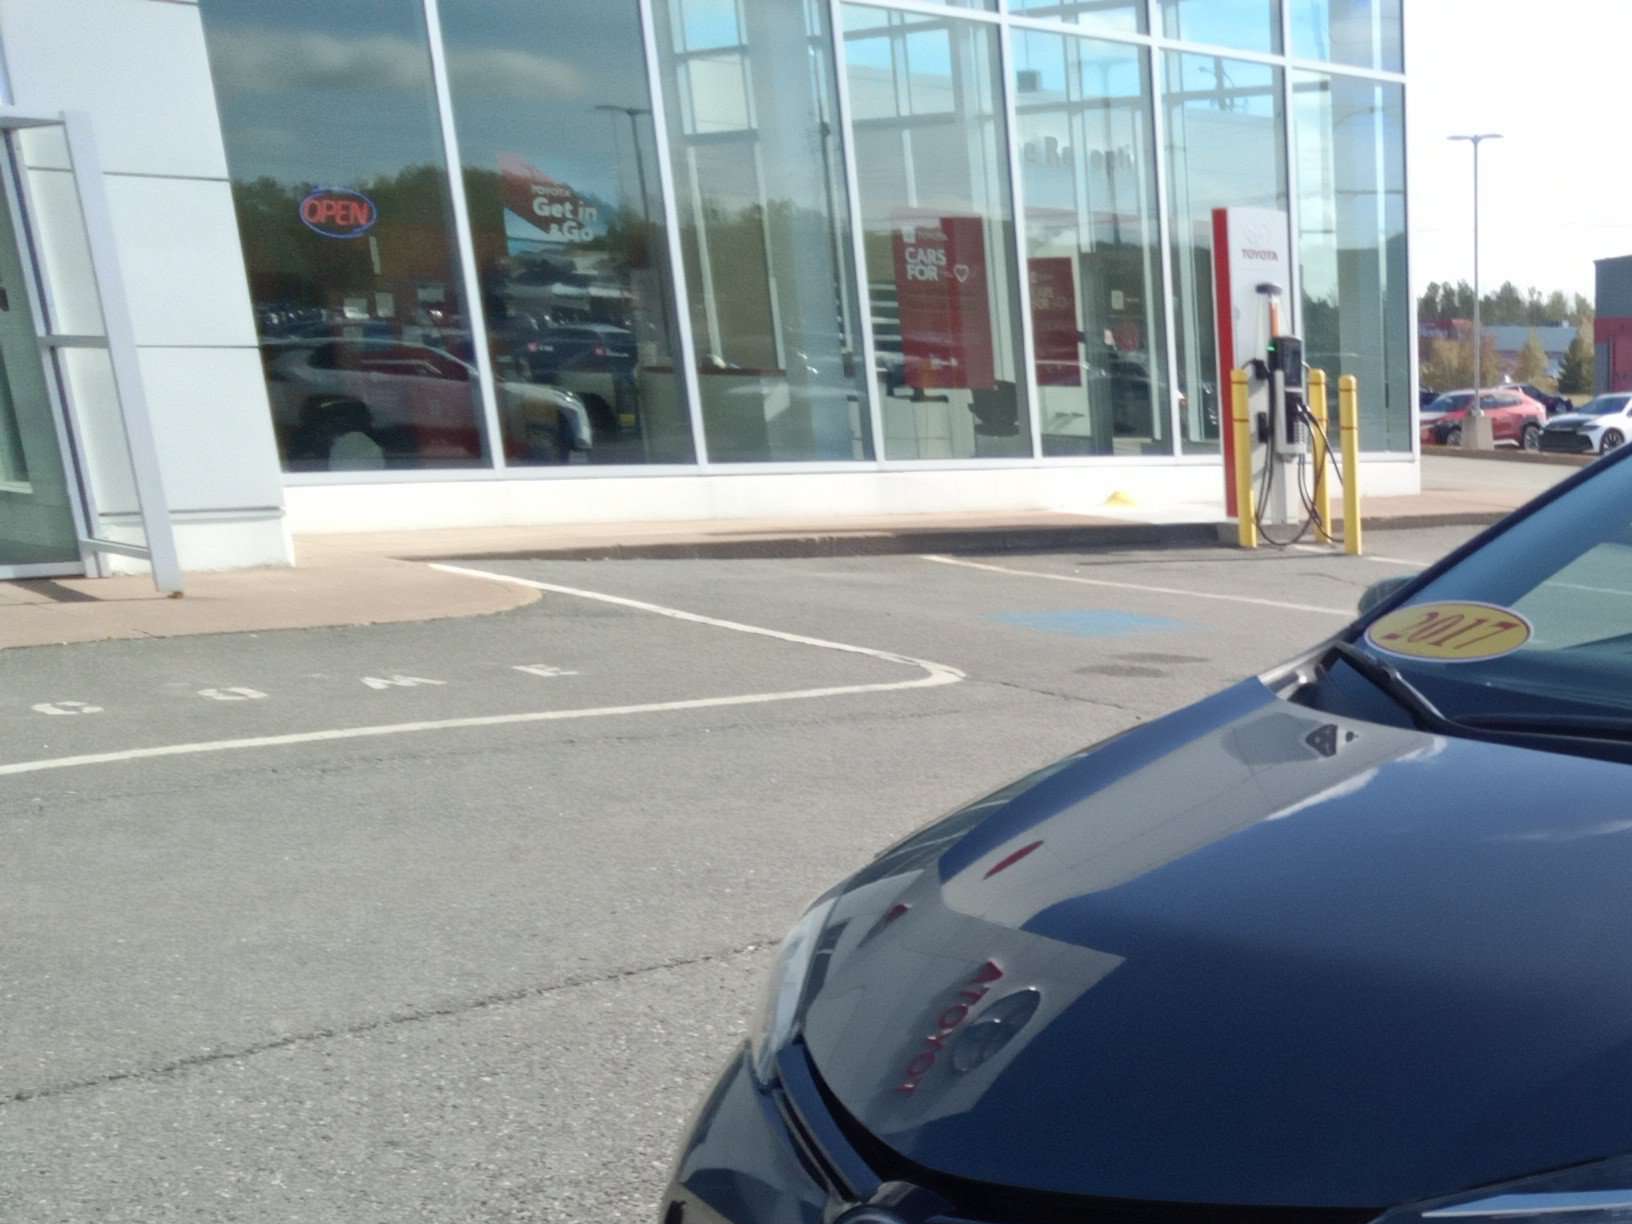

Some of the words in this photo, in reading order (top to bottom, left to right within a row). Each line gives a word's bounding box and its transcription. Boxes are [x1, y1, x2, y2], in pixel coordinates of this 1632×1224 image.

[304, 199, 369, 226] OPEN
[532, 196, 573, 219] Get
[577, 200, 598, 222] in
[904, 247, 948, 266] CARS
[1241, 249, 1279, 263] TOYOTA
[906, 264, 939, 281] FOR
[1380, 611, 1519, 651] 2017
